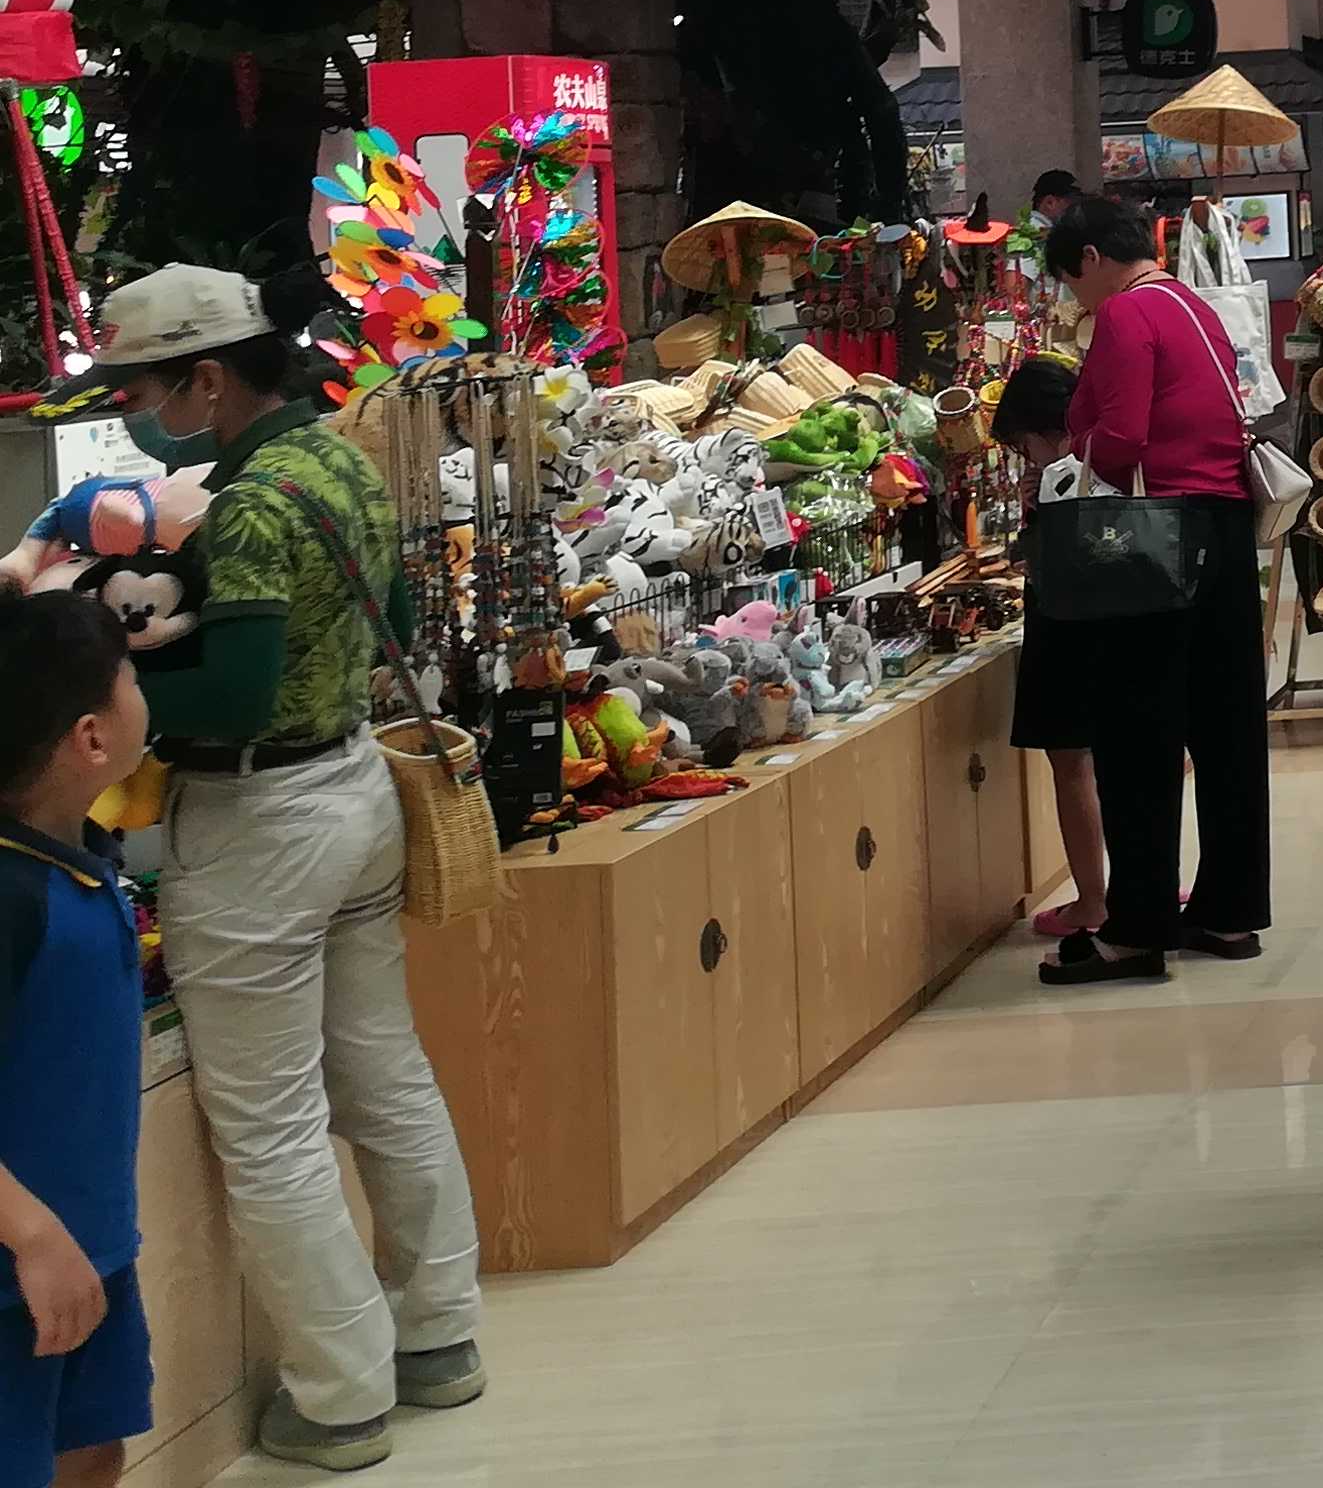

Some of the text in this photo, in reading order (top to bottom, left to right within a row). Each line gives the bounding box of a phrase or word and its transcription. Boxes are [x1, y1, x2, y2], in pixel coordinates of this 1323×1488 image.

[1139, 49, 1196, 66] 德克士
[553, 73, 608, 112] 农夫山泉
